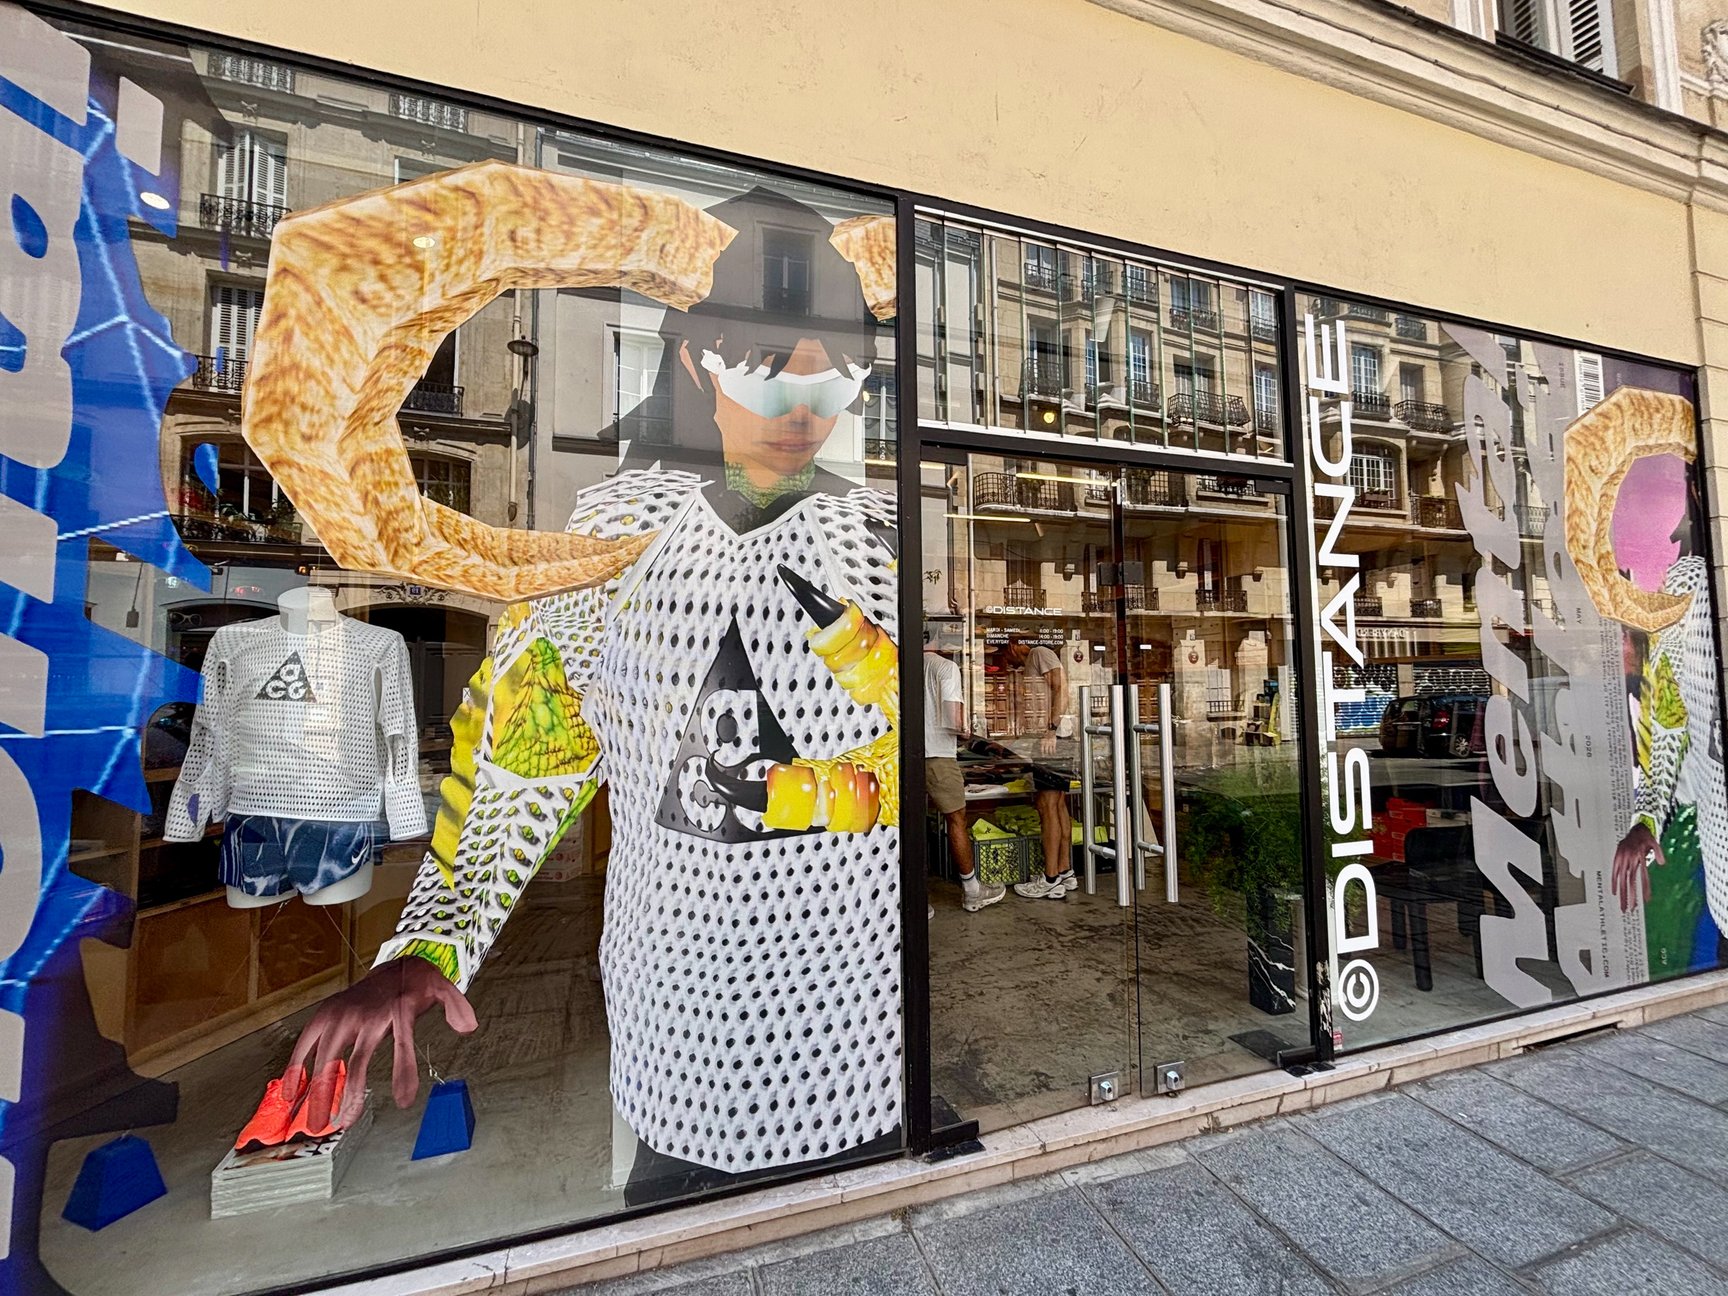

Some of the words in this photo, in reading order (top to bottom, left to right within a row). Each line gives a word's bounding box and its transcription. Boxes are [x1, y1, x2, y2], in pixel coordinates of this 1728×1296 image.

[1441, 321, 1553, 1009] Mental
[1575, 607, 1583, 625] MAY
[1596, 870, 1610, 979] MENTALATHLETIC.COM
